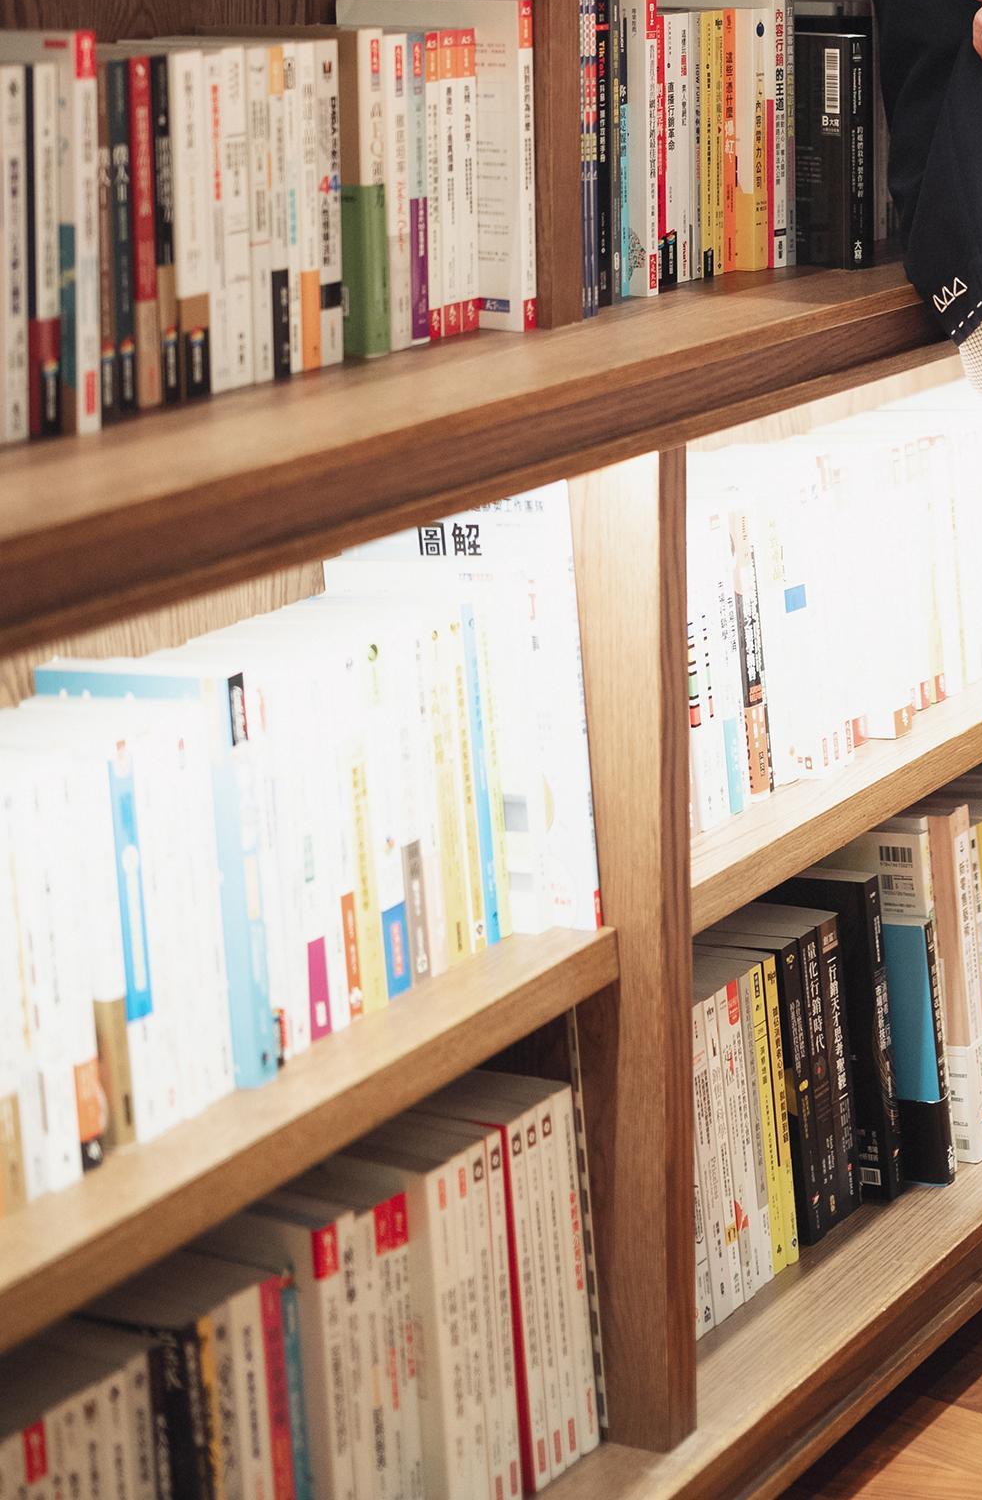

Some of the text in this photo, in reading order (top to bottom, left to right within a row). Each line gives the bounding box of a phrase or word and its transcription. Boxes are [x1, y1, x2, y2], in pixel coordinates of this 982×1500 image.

[416, 521, 482, 556] 圖解
[807, 941, 826, 1054] 量化行銷時代
